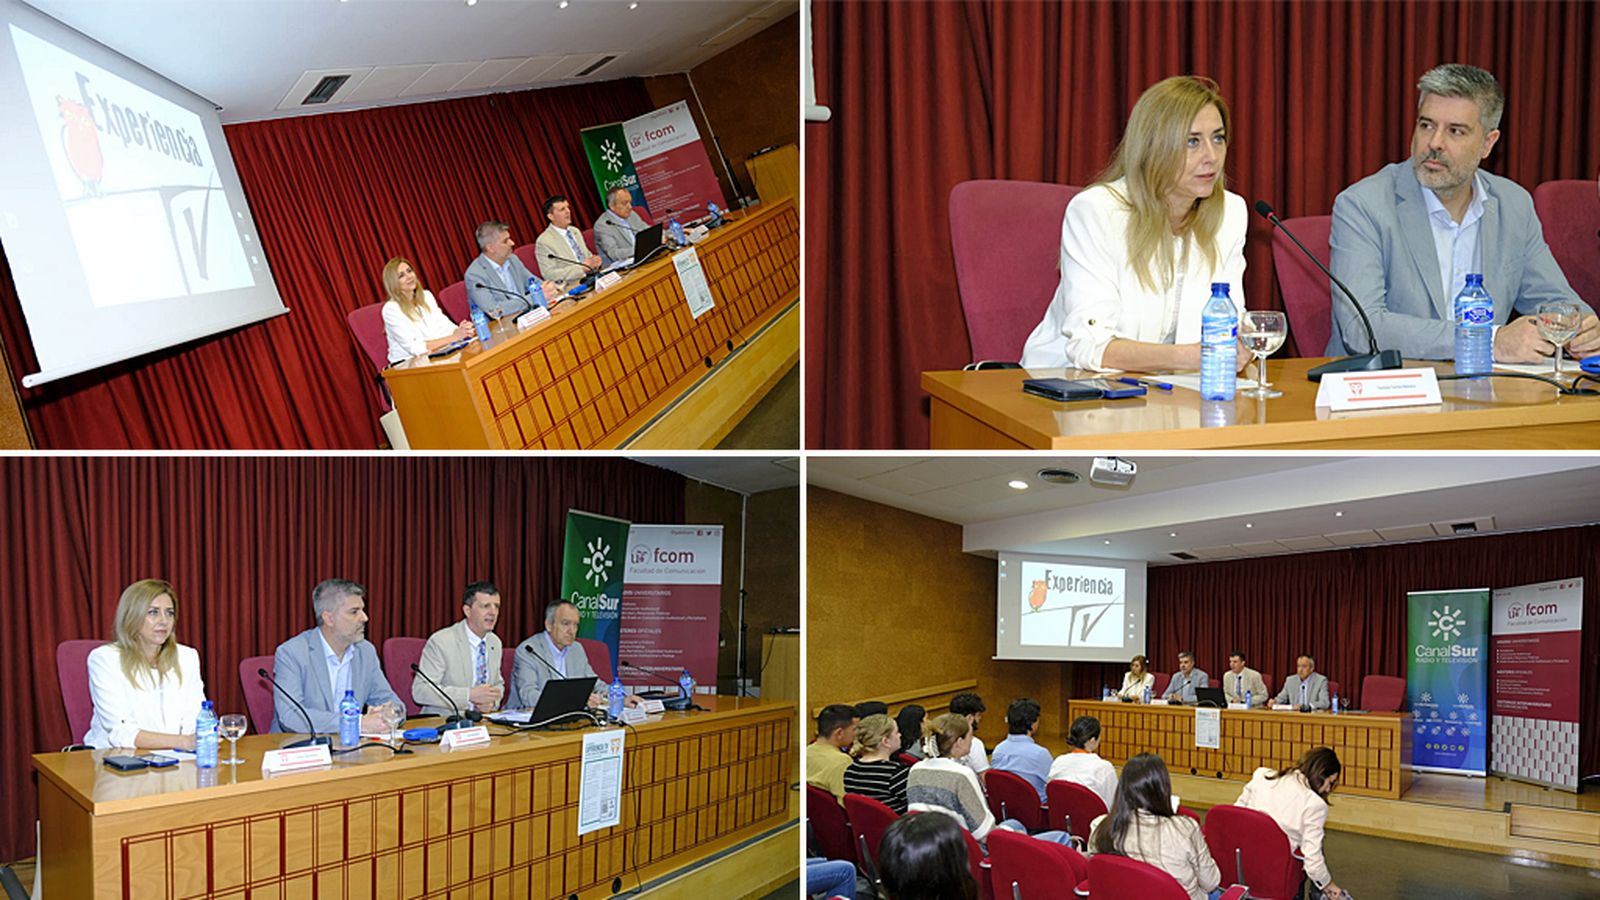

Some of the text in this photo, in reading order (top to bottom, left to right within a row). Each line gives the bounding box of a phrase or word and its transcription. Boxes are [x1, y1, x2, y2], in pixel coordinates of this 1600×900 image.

[75, 72, 203, 168] Experiencia
[644, 124, 676, 142] fcom
[653, 547, 695, 564] fcom
[1045, 569, 1114, 596] Experiencia
[571, 591, 620, 611] CanalSur
[1525, 602, 1558, 617] fcom
[1415, 644, 1479, 658] CanalSur
